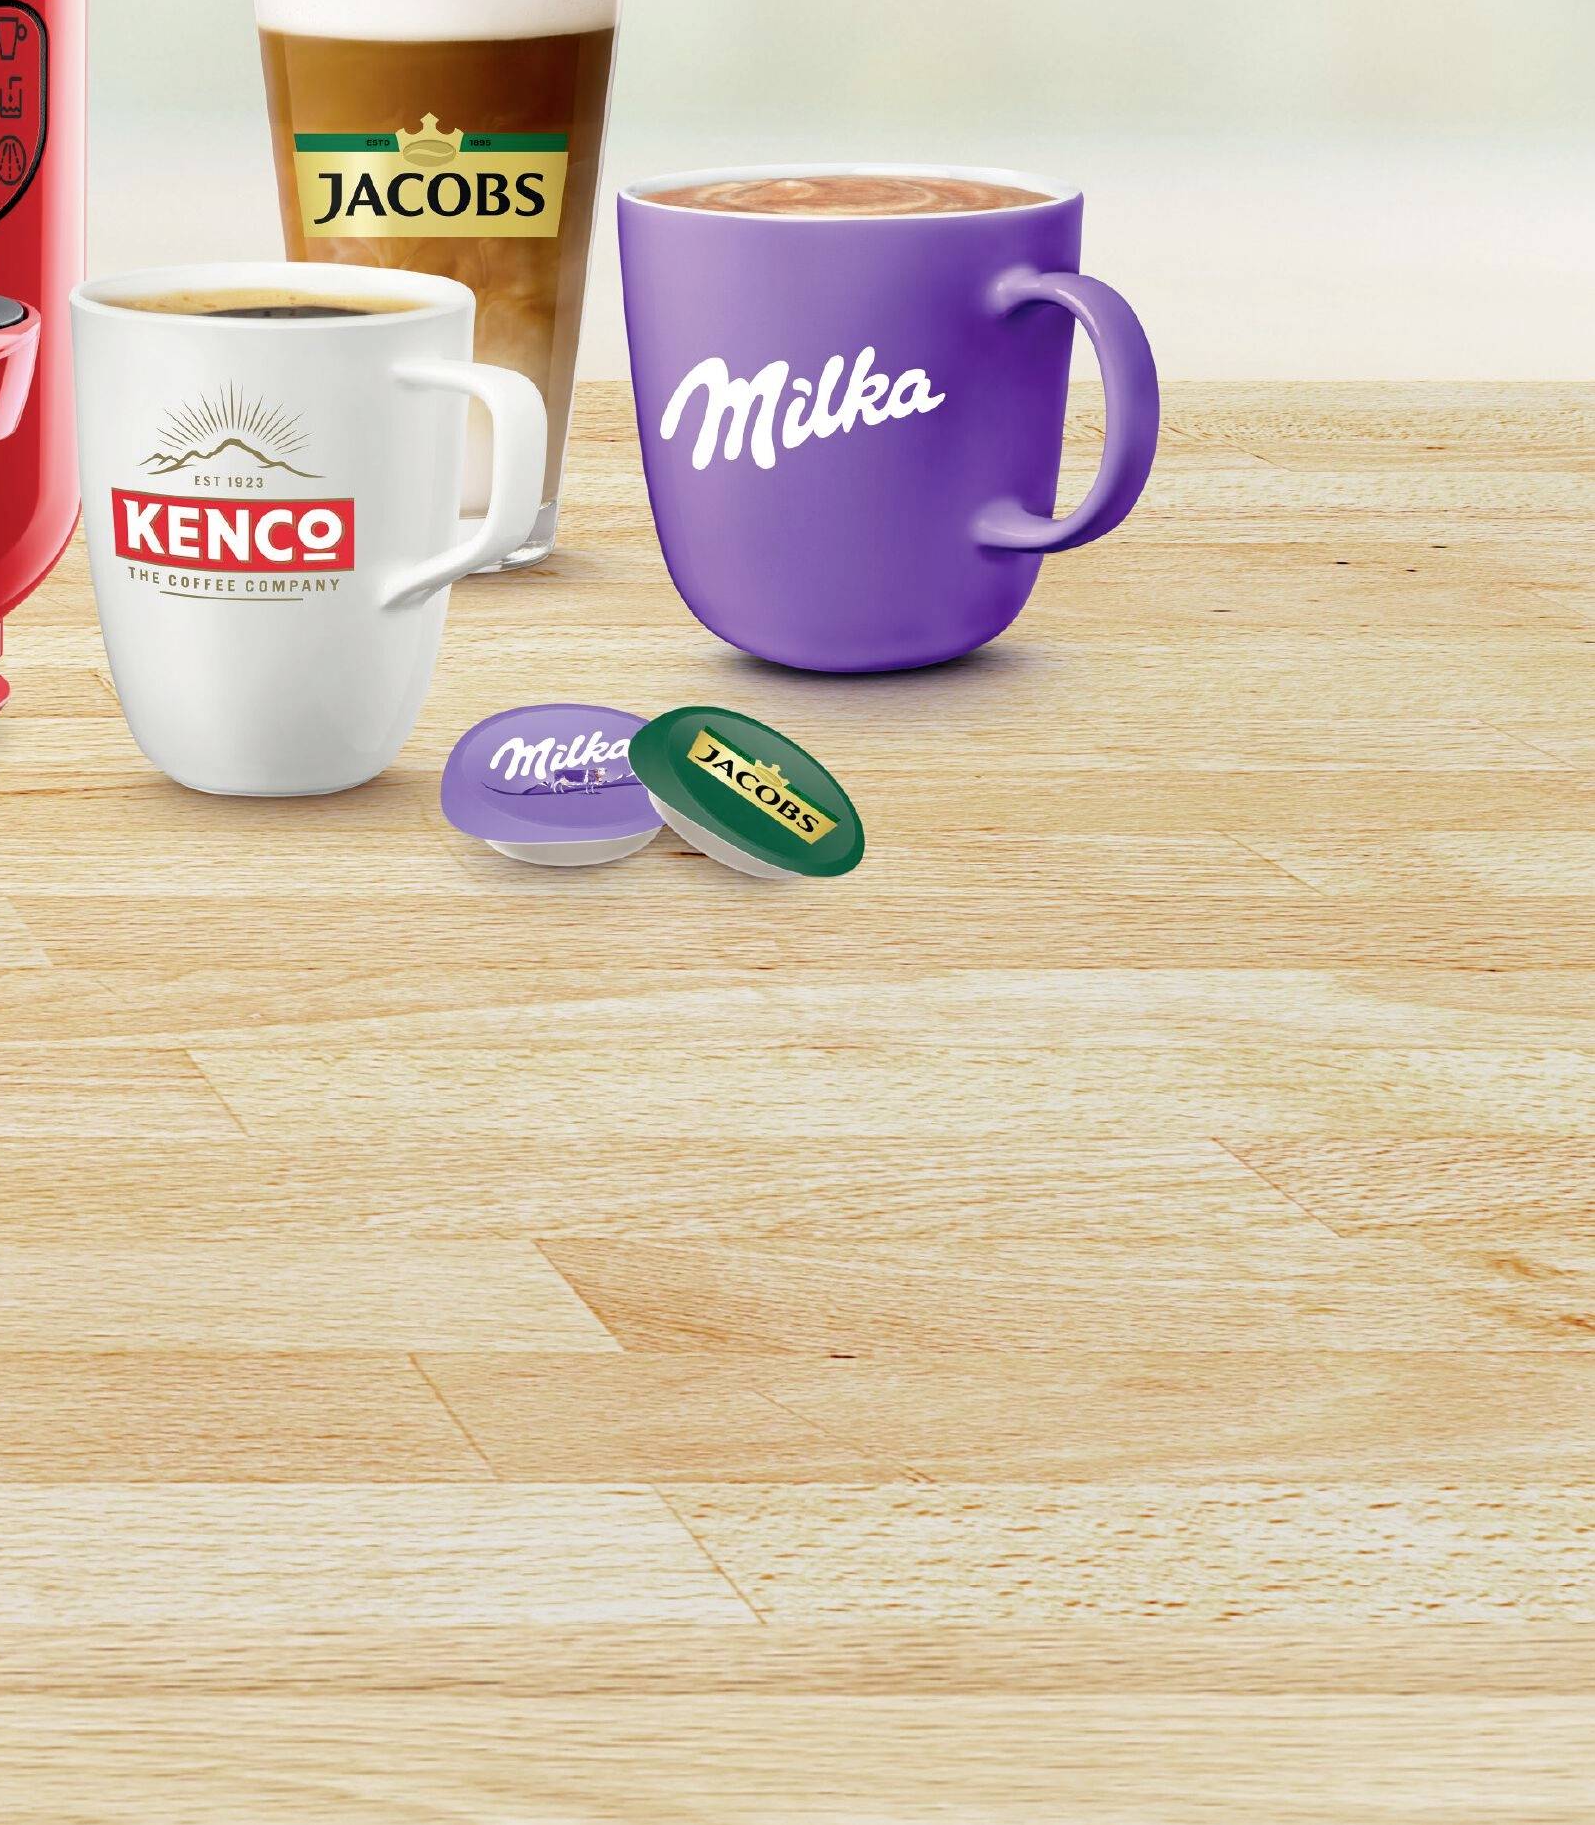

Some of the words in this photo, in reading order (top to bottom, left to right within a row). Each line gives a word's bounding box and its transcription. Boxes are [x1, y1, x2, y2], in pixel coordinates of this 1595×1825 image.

[313, 173, 545, 225] JACOBS
[659, 346, 946, 470] Milka
[194, 476, 221, 486] EST
[227, 477, 264, 488] 1923
[122, 498, 343, 562] KENCO
[128, 566, 160, 584] THE
[168, 574, 236, 592] COFFEE
[245, 579, 340, 592] COMPANY
[489, 731, 631, 780] Milka
[694, 744, 819, 833] JACOBS
